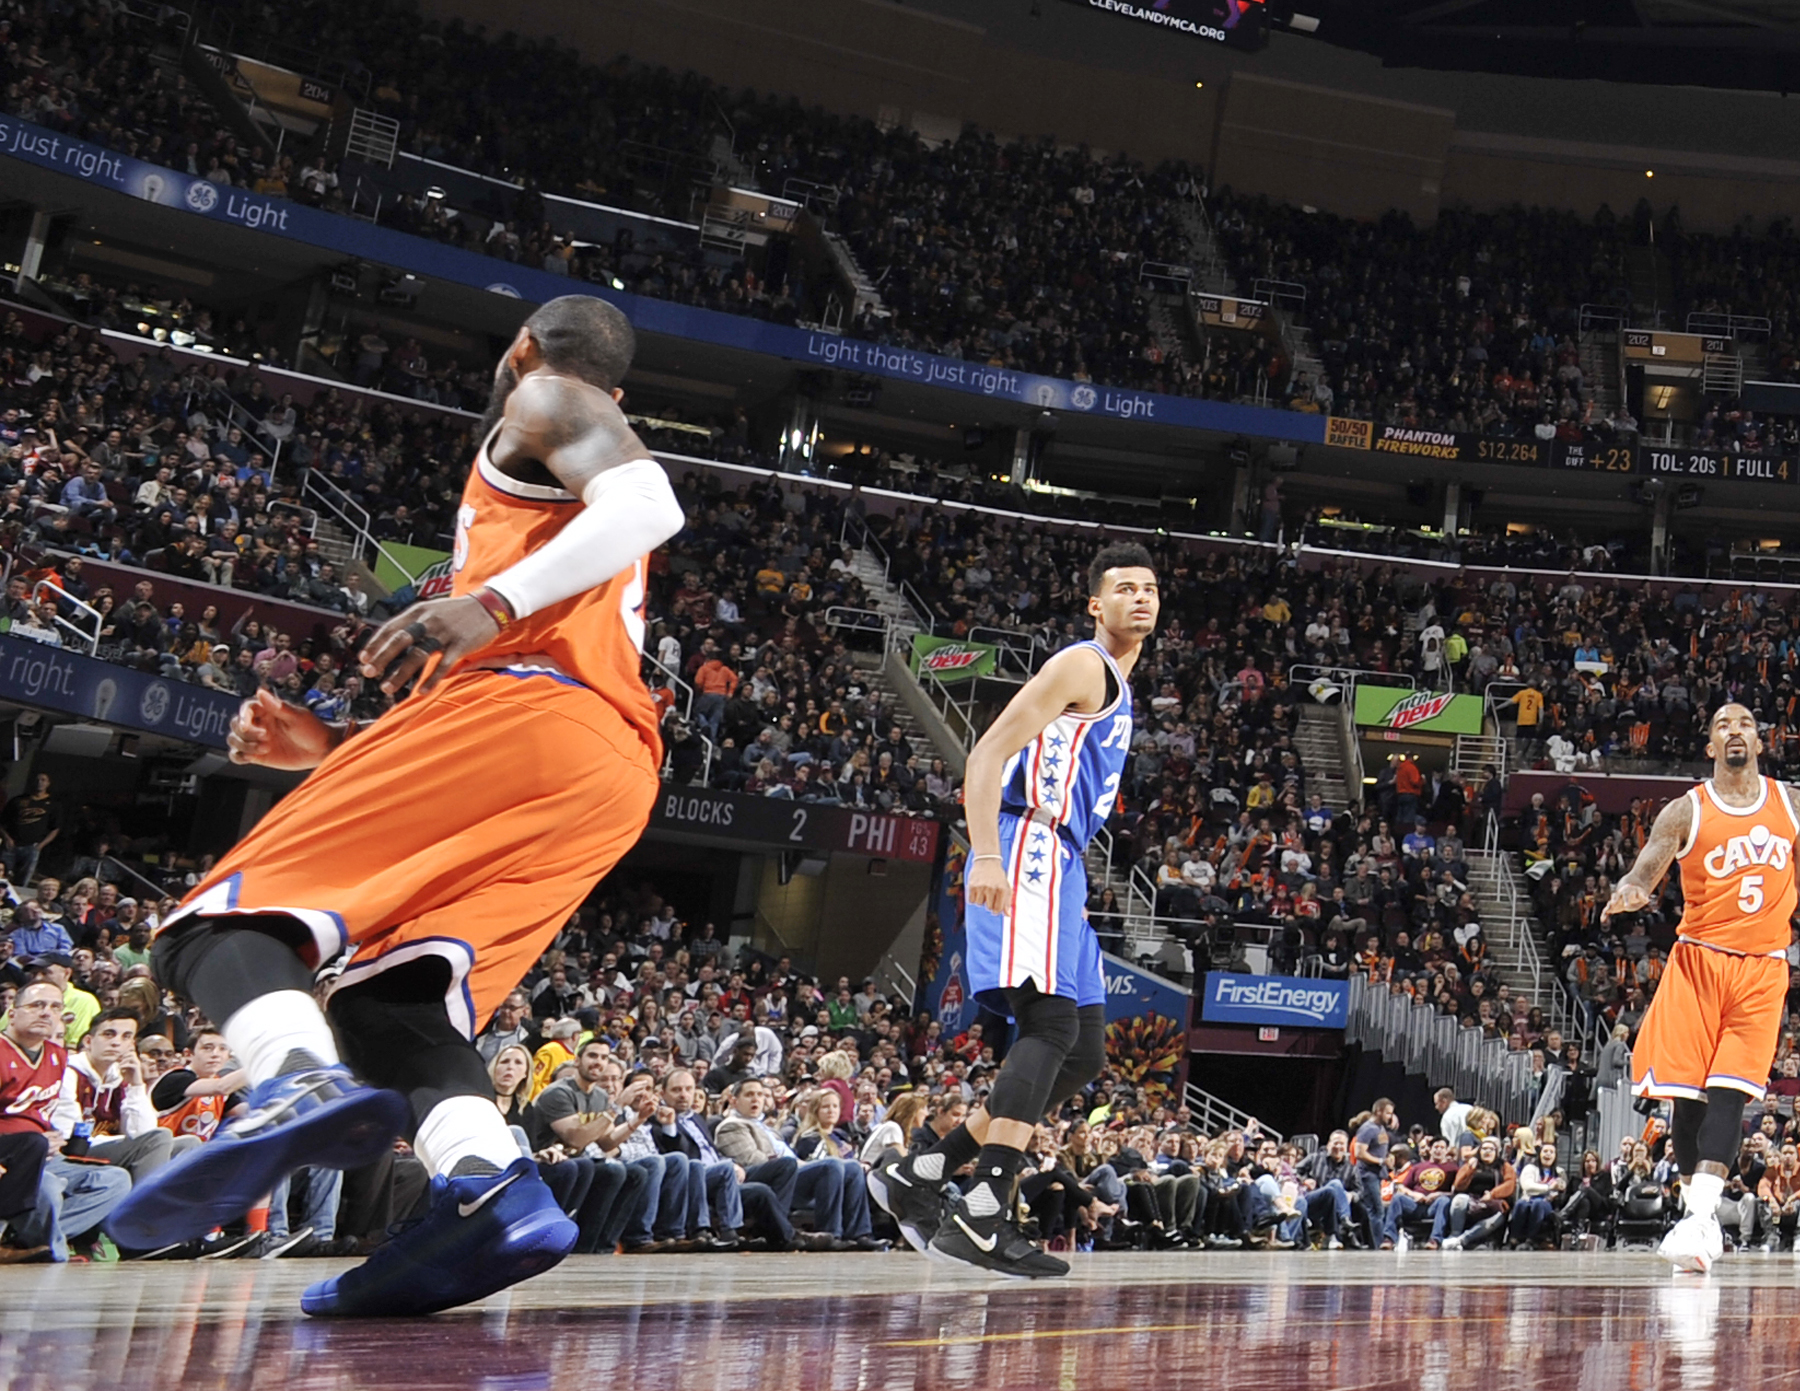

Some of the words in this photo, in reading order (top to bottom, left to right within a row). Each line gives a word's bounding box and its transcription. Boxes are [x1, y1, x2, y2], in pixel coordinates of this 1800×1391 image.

[10, 124, 60, 160] just
[65, 145, 125, 182] right.
[227, 195, 289, 230] Light
[808, 335, 860, 365] Light
[866, 346, 924, 375] that's
[926, 363, 965, 384] just
[970, 368, 1022, 395] right.
[1104, 393, 1154, 419] Light
[1329, 434, 1366, 449] RAFFLE
[1330, 419, 1367, 436] 50/50
[1384, 427, 1455, 446] PHANTOM
[1376, 439, 1460, 459] FIREWORKS
[1477, 440, 1538, 461] $12,264
[1736, 457, 1774, 479] FULL
[1777, 459, 1789, 481] 4
[9, 649, 75, 697] right.
[174, 695, 228, 737] Light
[664, 795, 734, 826] BLOCKS
[789, 809, 807, 841] 2
[848, 814, 896, 852] PHI
[909, 836, 929, 856] 43
[1703, 827, 1792, 879] CAVS
[1737, 875, 1764, 914] 5
[1215, 979, 1340, 1014] FirstEnergy
